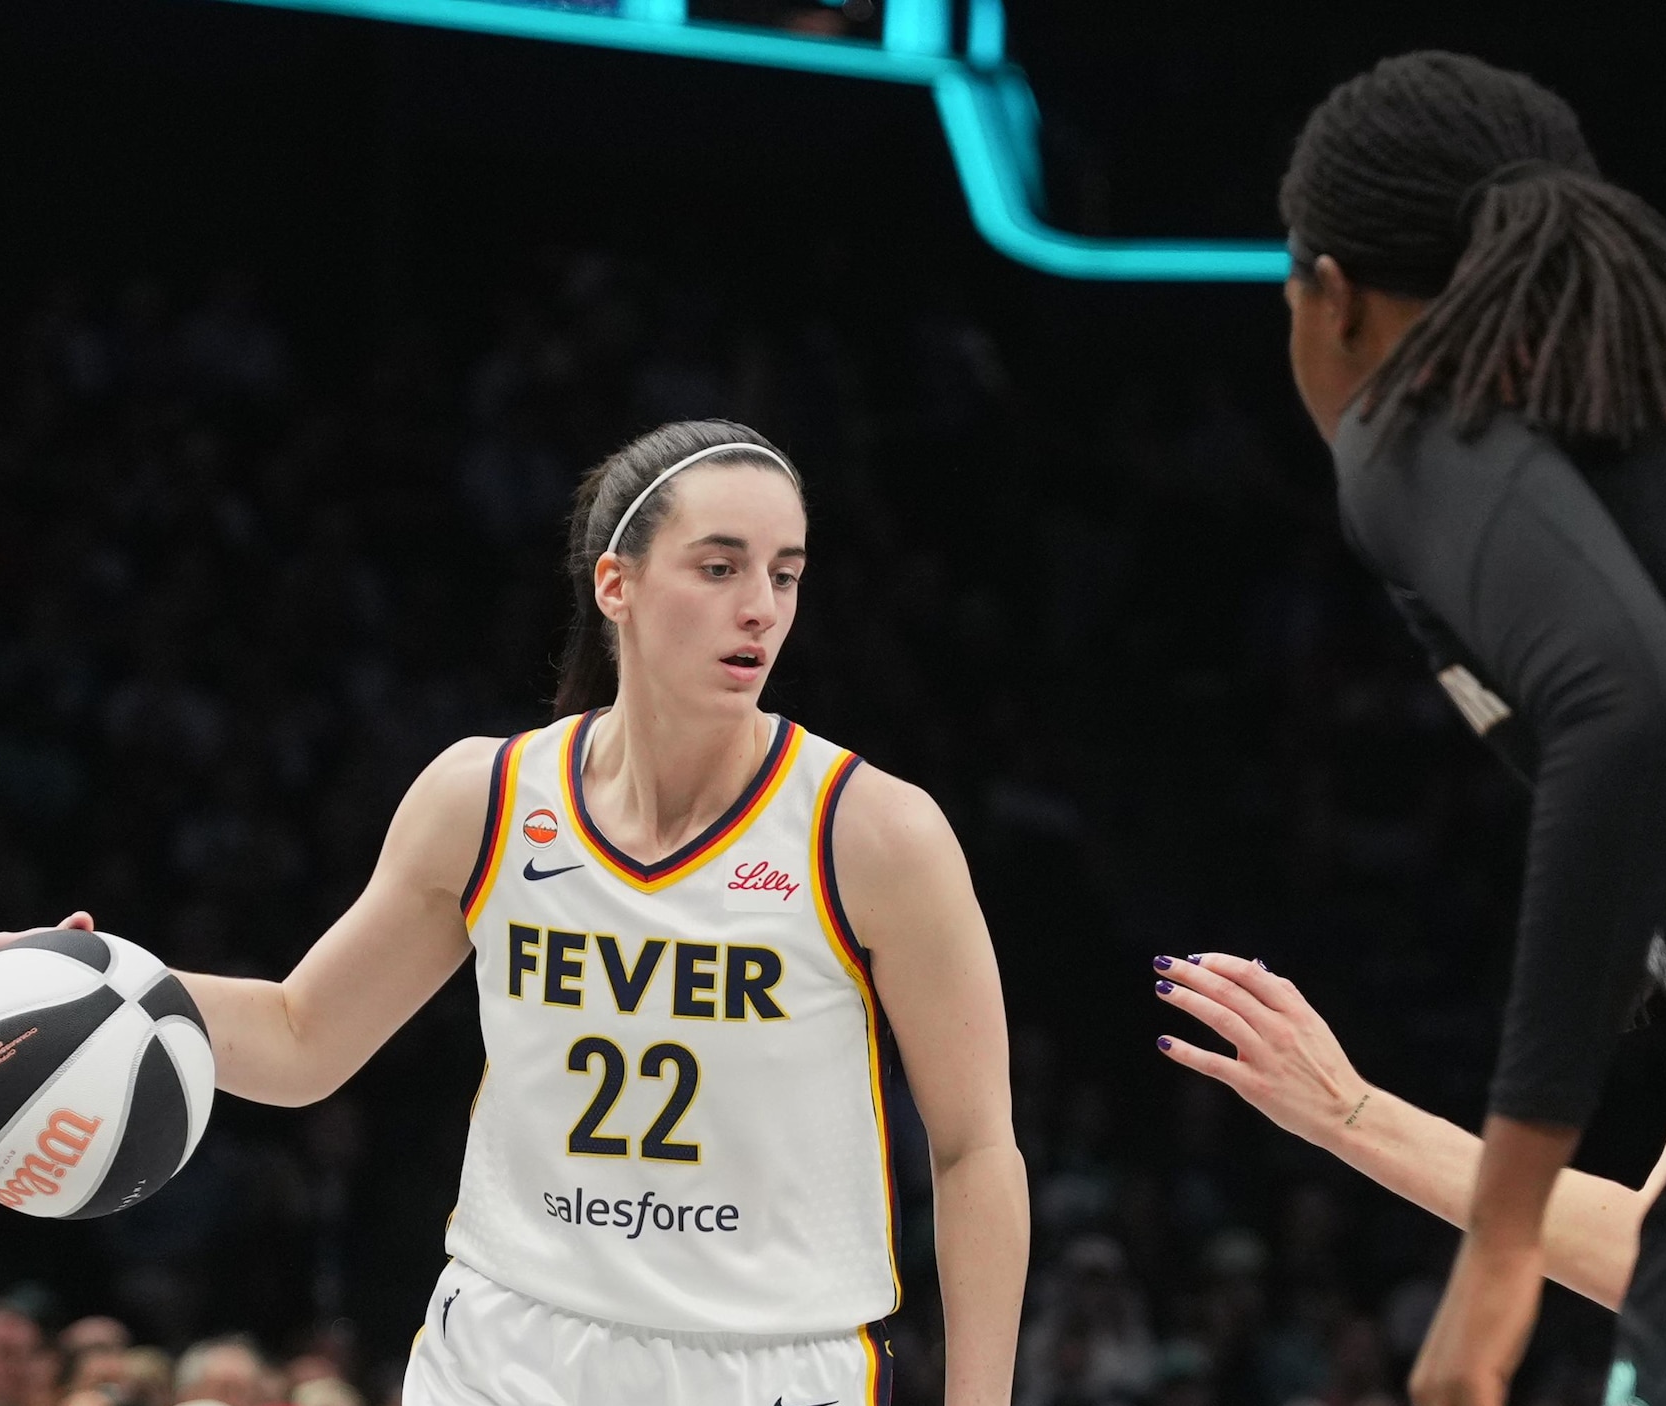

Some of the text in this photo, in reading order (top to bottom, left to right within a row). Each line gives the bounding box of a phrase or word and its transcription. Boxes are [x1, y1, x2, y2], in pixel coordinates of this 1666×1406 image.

[727, 860, 800, 901] Lilly
[508, 920, 791, 1022] FEVER
[566, 1033, 701, 1165] 22
[544, 1187, 740, 1240] salesforce
